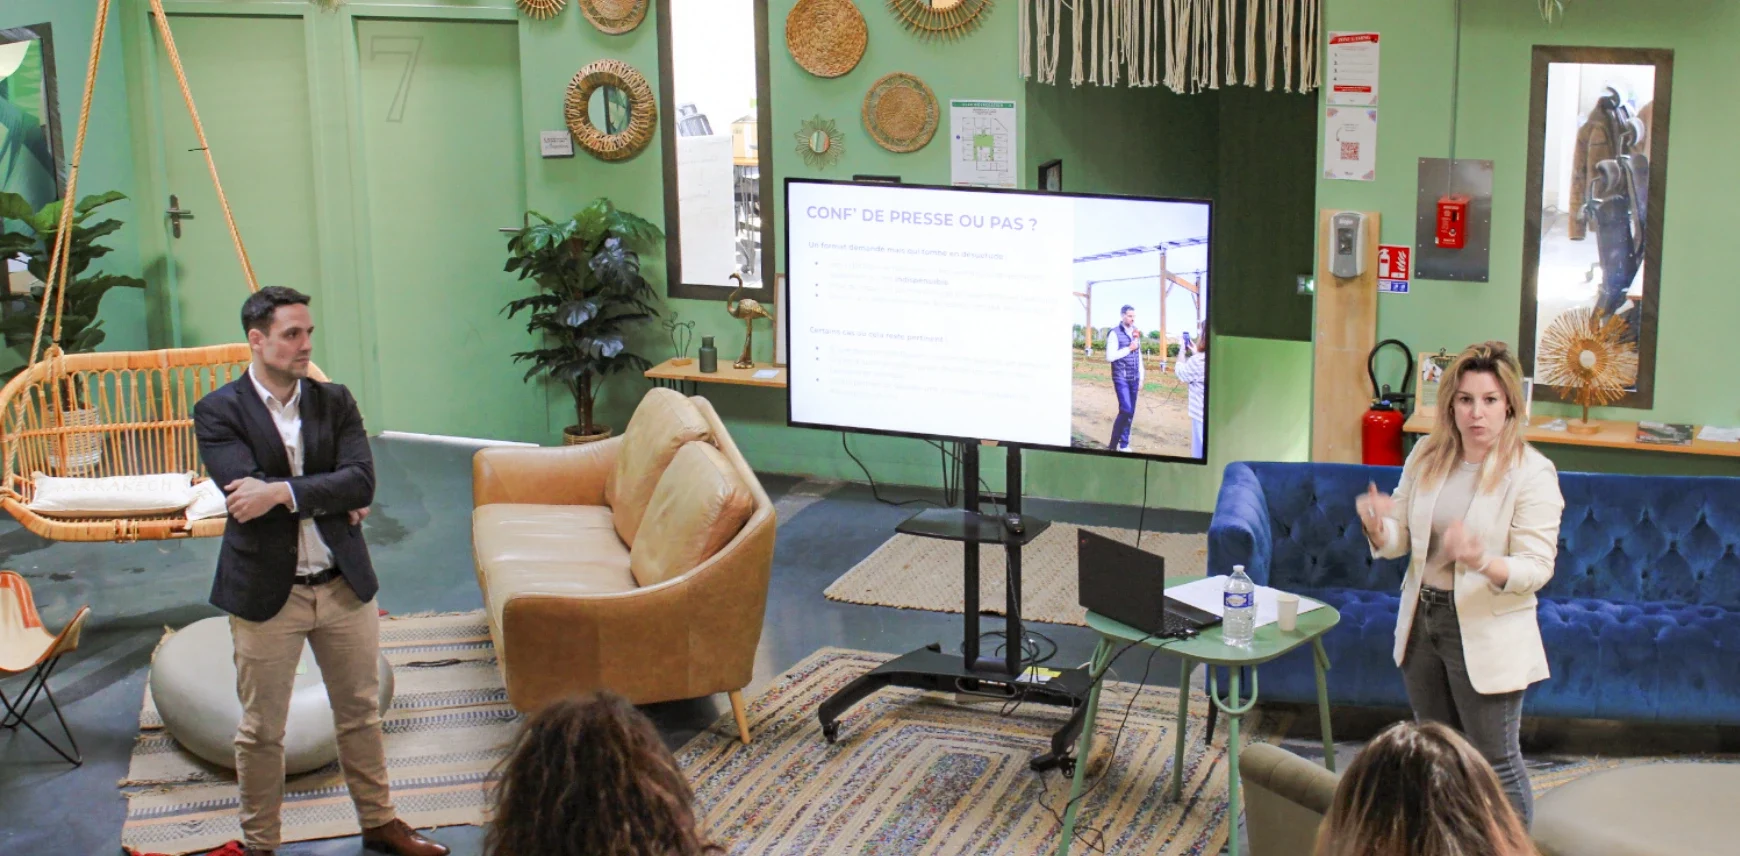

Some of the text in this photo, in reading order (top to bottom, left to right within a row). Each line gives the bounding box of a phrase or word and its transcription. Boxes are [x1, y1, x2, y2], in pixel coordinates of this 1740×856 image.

[370, 35, 423, 123] 7
[862, 208, 884, 222] DE
[890, 210, 953, 226] PRESSE
[959, 214, 984, 228] OU
[990, 216, 1024, 230] PAS
[1028, 218, 1038, 231] ?
[808, 241, 819, 249] Un
[821, 241, 847, 250] format
[887, 247, 905, 255] mais
[907, 247, 920, 256] qui
[921, 248, 947, 257] tombe
[809, 326, 841, 336] Certains
[886, 332, 905, 340] reste
[907, 334, 944, 342] pertinent
